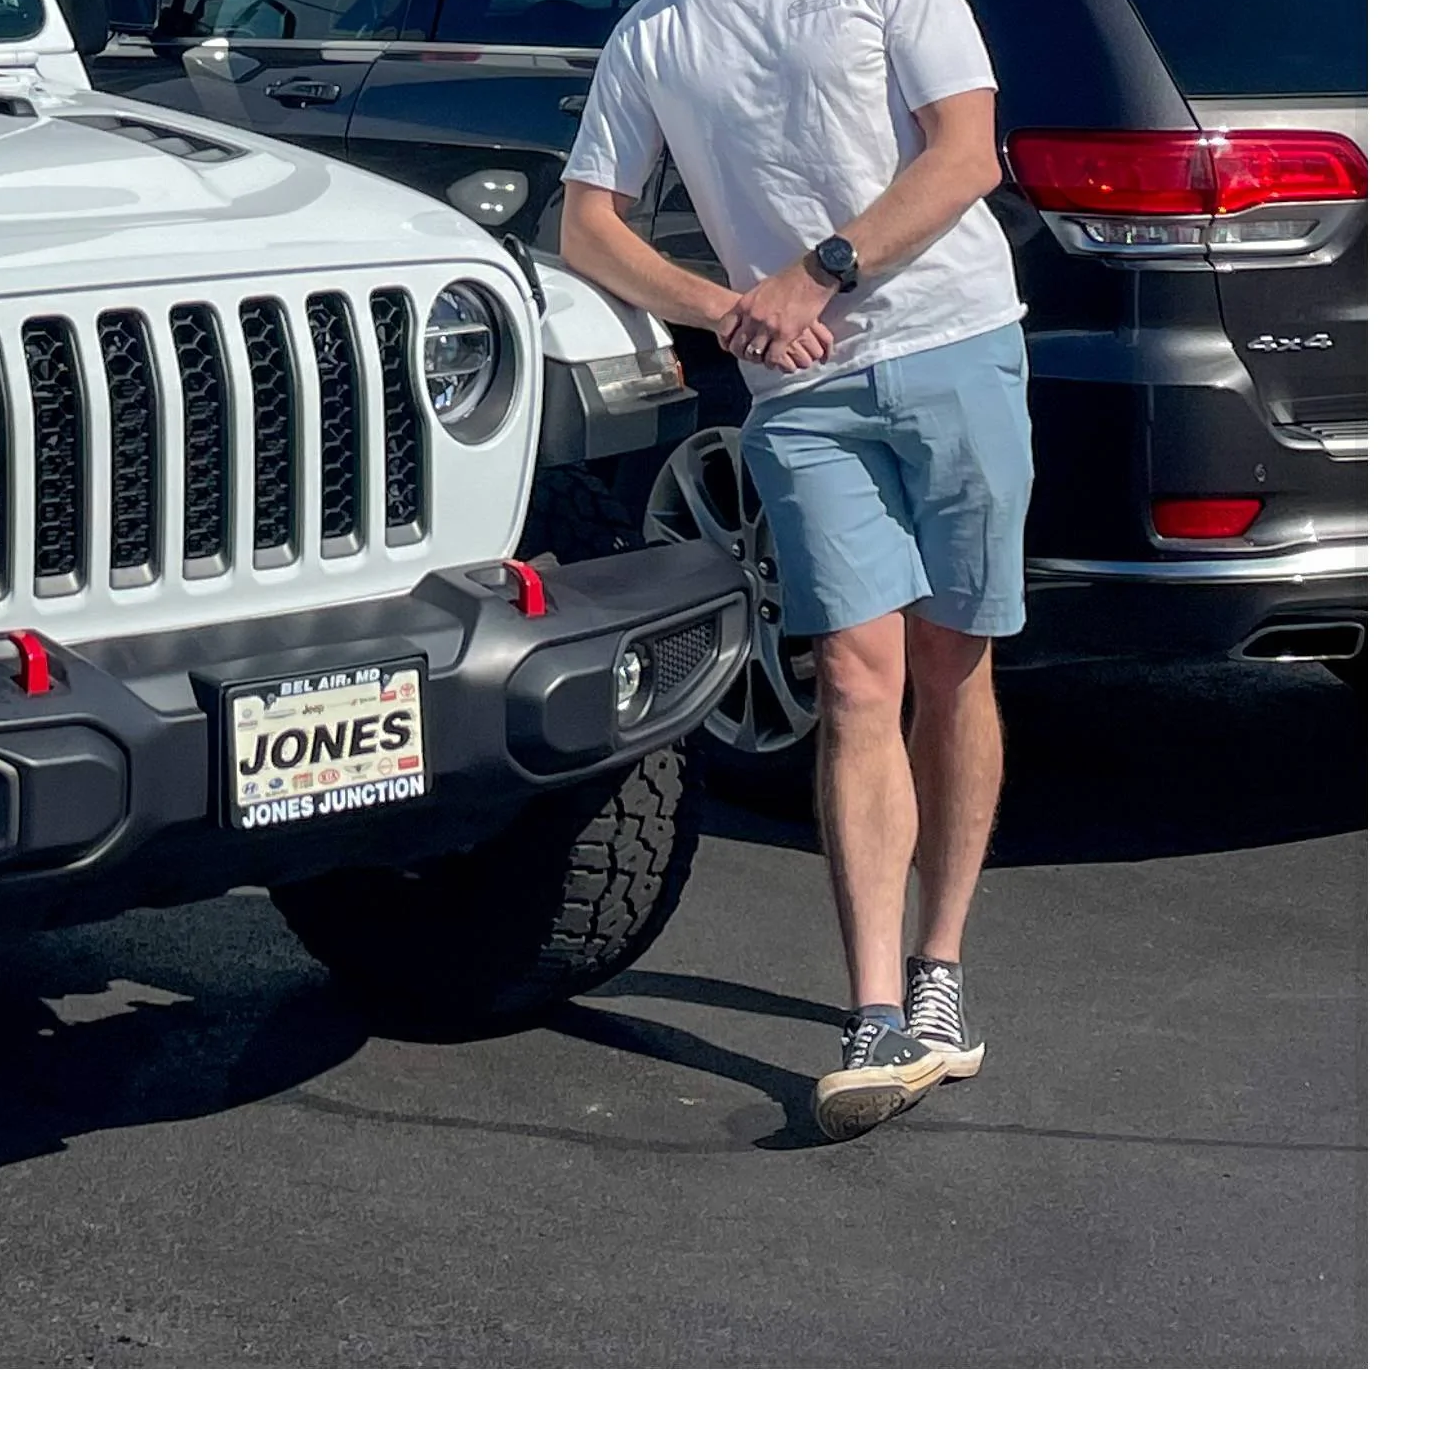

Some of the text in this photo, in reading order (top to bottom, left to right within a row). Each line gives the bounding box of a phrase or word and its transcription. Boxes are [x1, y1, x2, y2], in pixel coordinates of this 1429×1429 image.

[1247, 333, 1333, 351] 4x4
[280, 679, 313, 696] BEL
[355, 668, 380, 684] MD
[239, 711, 412, 776] JONES
[242, 795, 314, 829] JONES
[318, 774, 425, 814] JUNCTION
